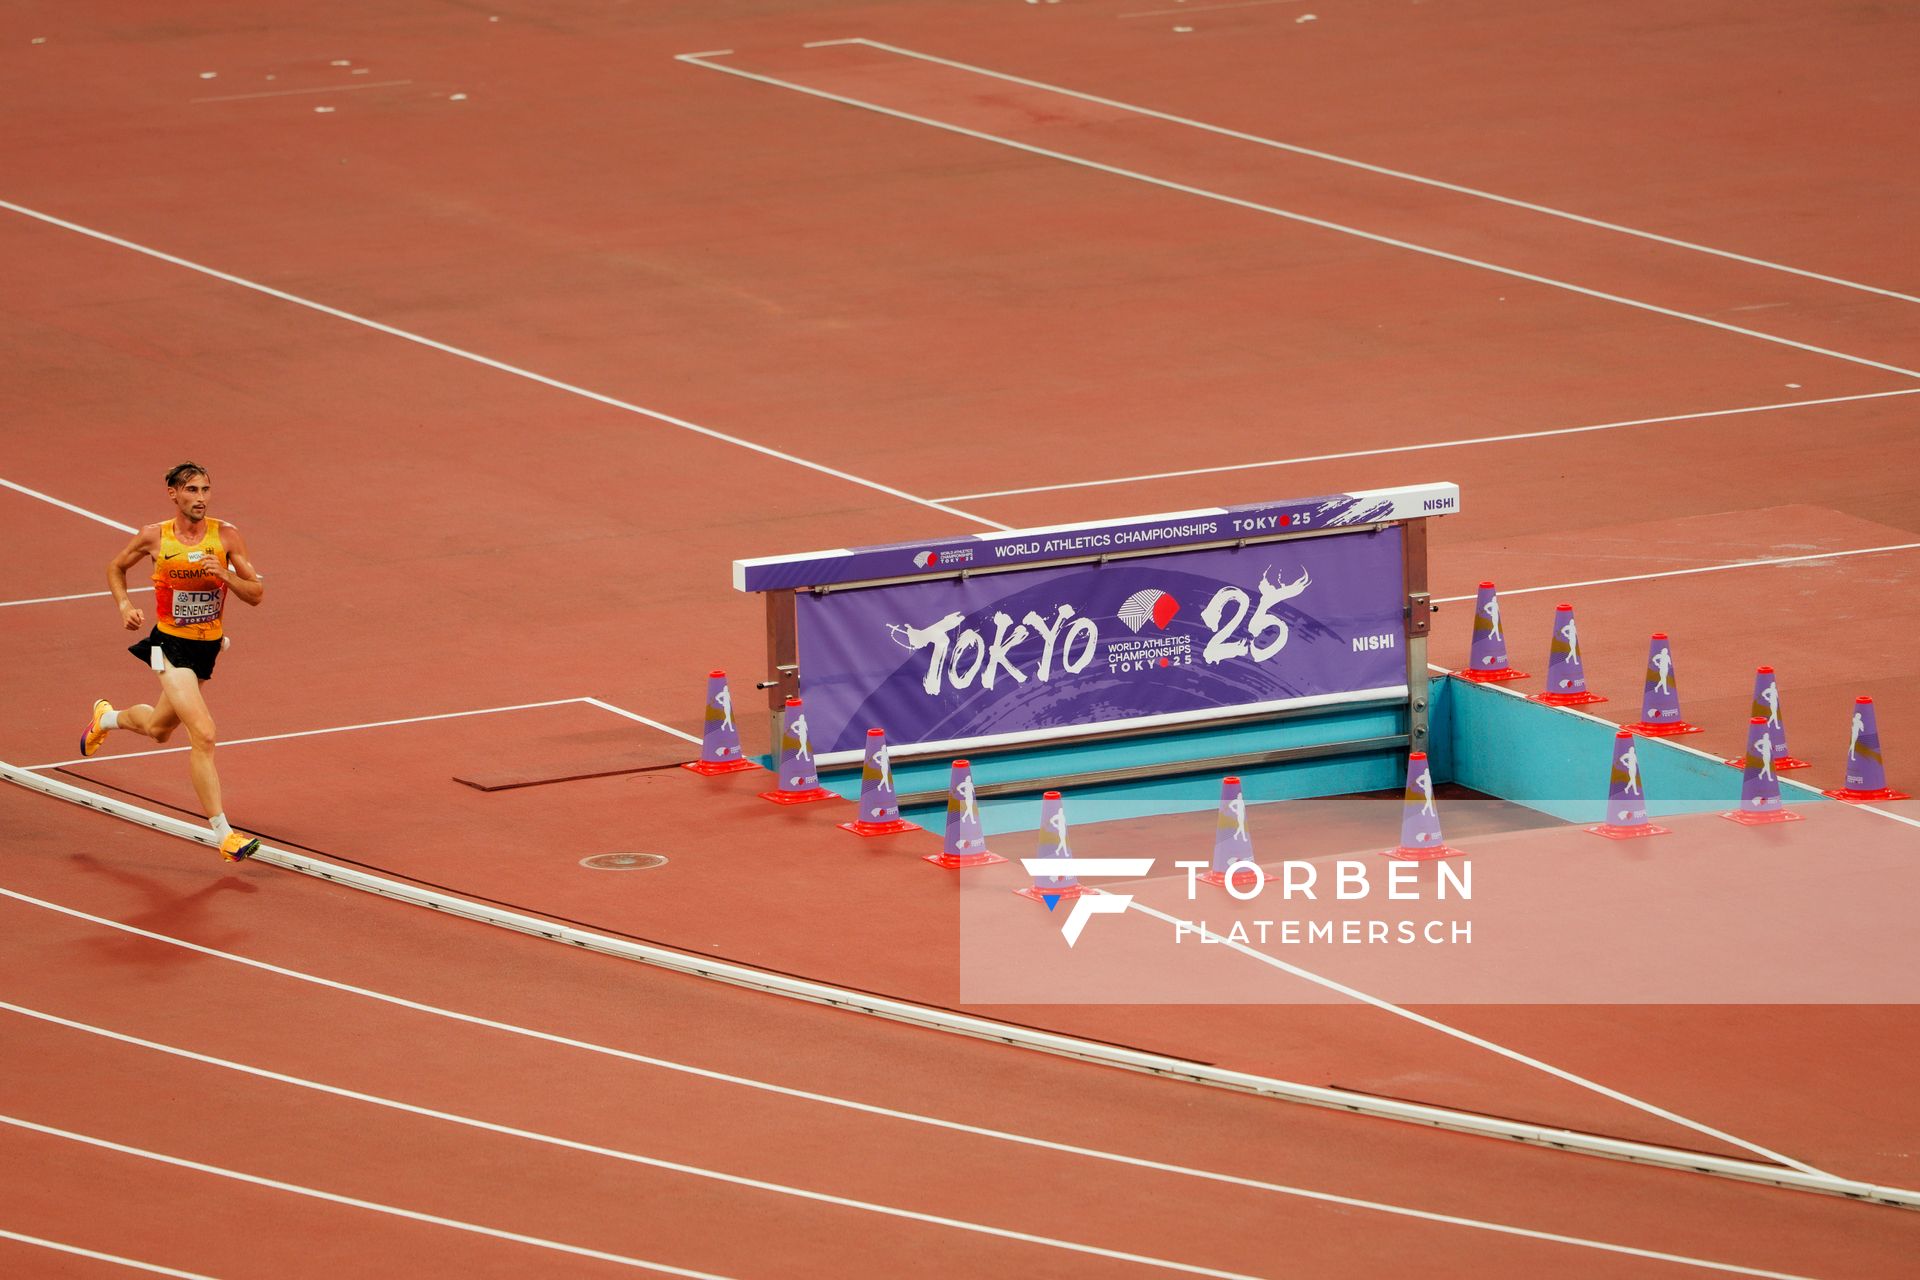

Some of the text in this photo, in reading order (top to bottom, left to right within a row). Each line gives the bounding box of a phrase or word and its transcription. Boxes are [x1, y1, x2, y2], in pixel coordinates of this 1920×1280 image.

[1423, 497, 1455, 511] NISHI
[995, 522, 1218, 557] WORLD ATHLETICS CHAMPIONSHIPS
[188, 590, 220, 602] TDK
[174, 602, 220, 616] BIENENFELD
[1201, 564, 1312, 665] 25
[886, 604, 1098, 695] TOKYO
[1108, 635, 1191, 653] WORLD ATHLETICS
[1353, 634, 1394, 652] NISHI
[1108, 645, 1191, 663] CHAMPIONSHIPS
